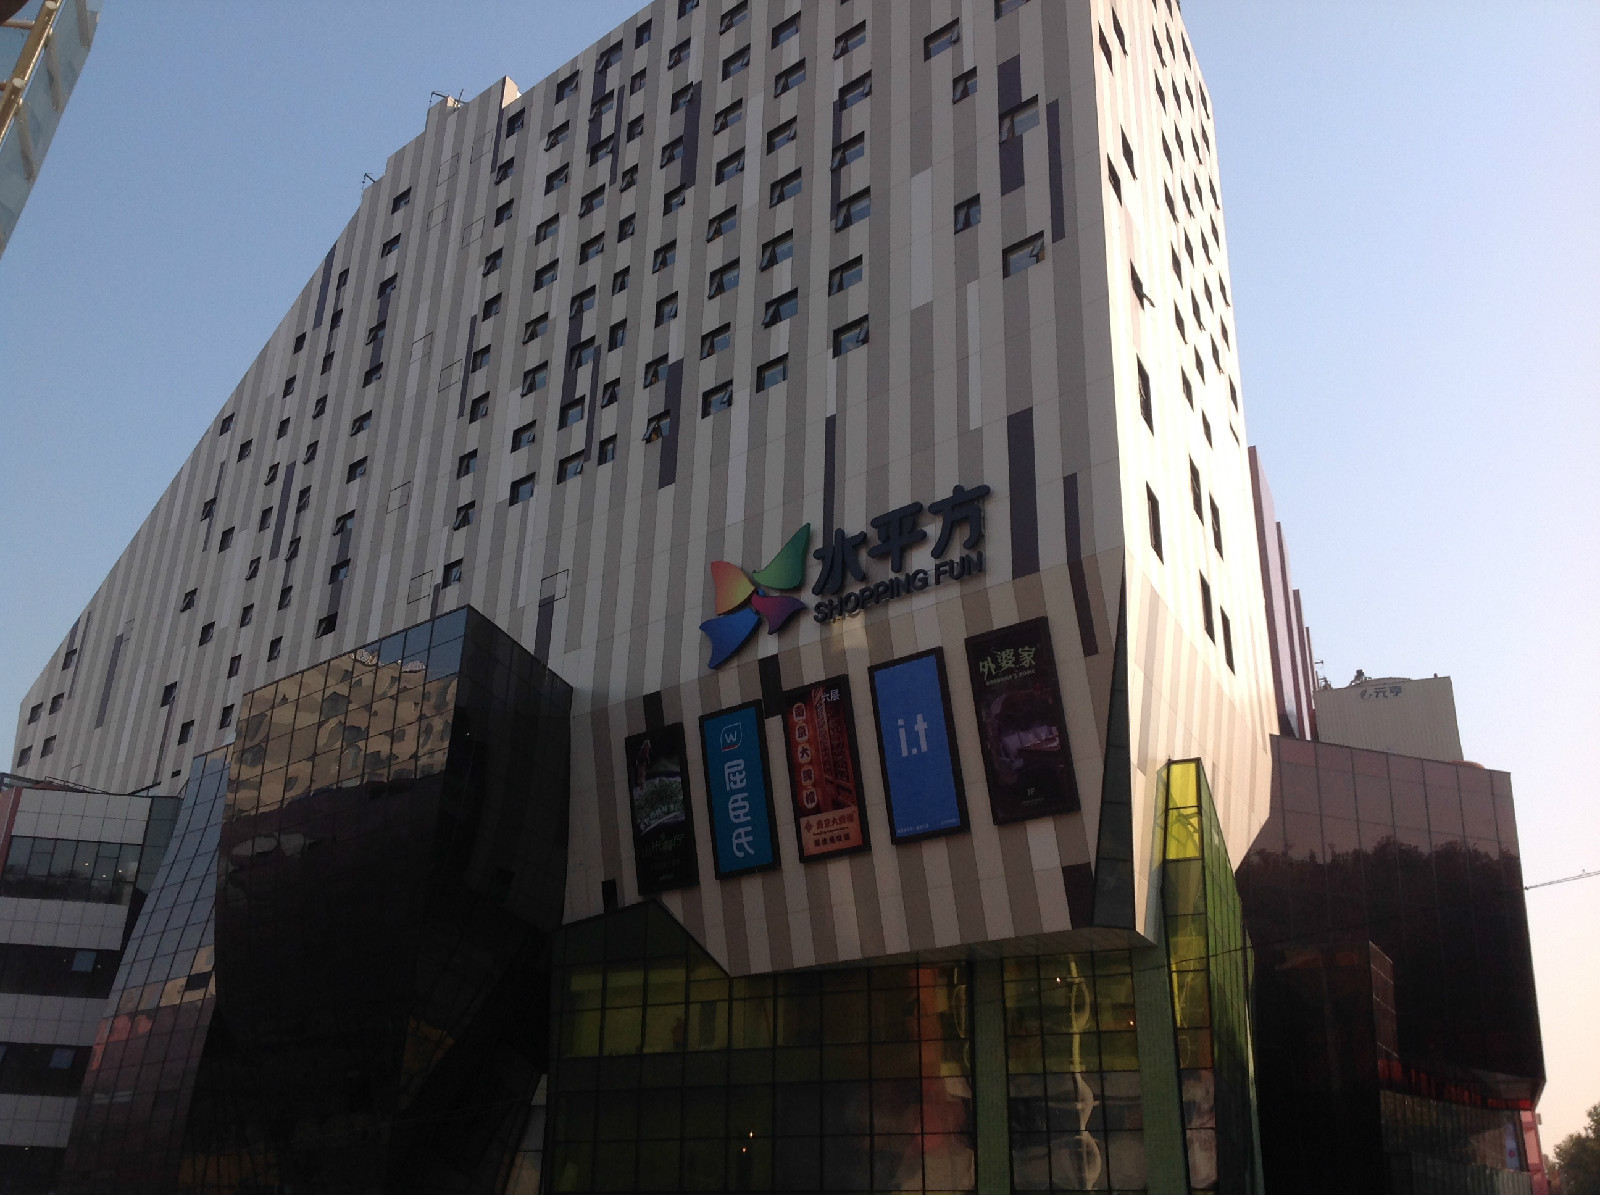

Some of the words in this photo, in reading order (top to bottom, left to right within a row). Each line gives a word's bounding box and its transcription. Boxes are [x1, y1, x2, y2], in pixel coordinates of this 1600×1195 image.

[812, 485, 991, 594] 水平方
[813, 568, 928, 624] SHOPPING
[934, 551, 983, 586] FUN
[979, 645, 1036, 681] 外婆家
[724, 759, 755, 858] 屈臣氏
